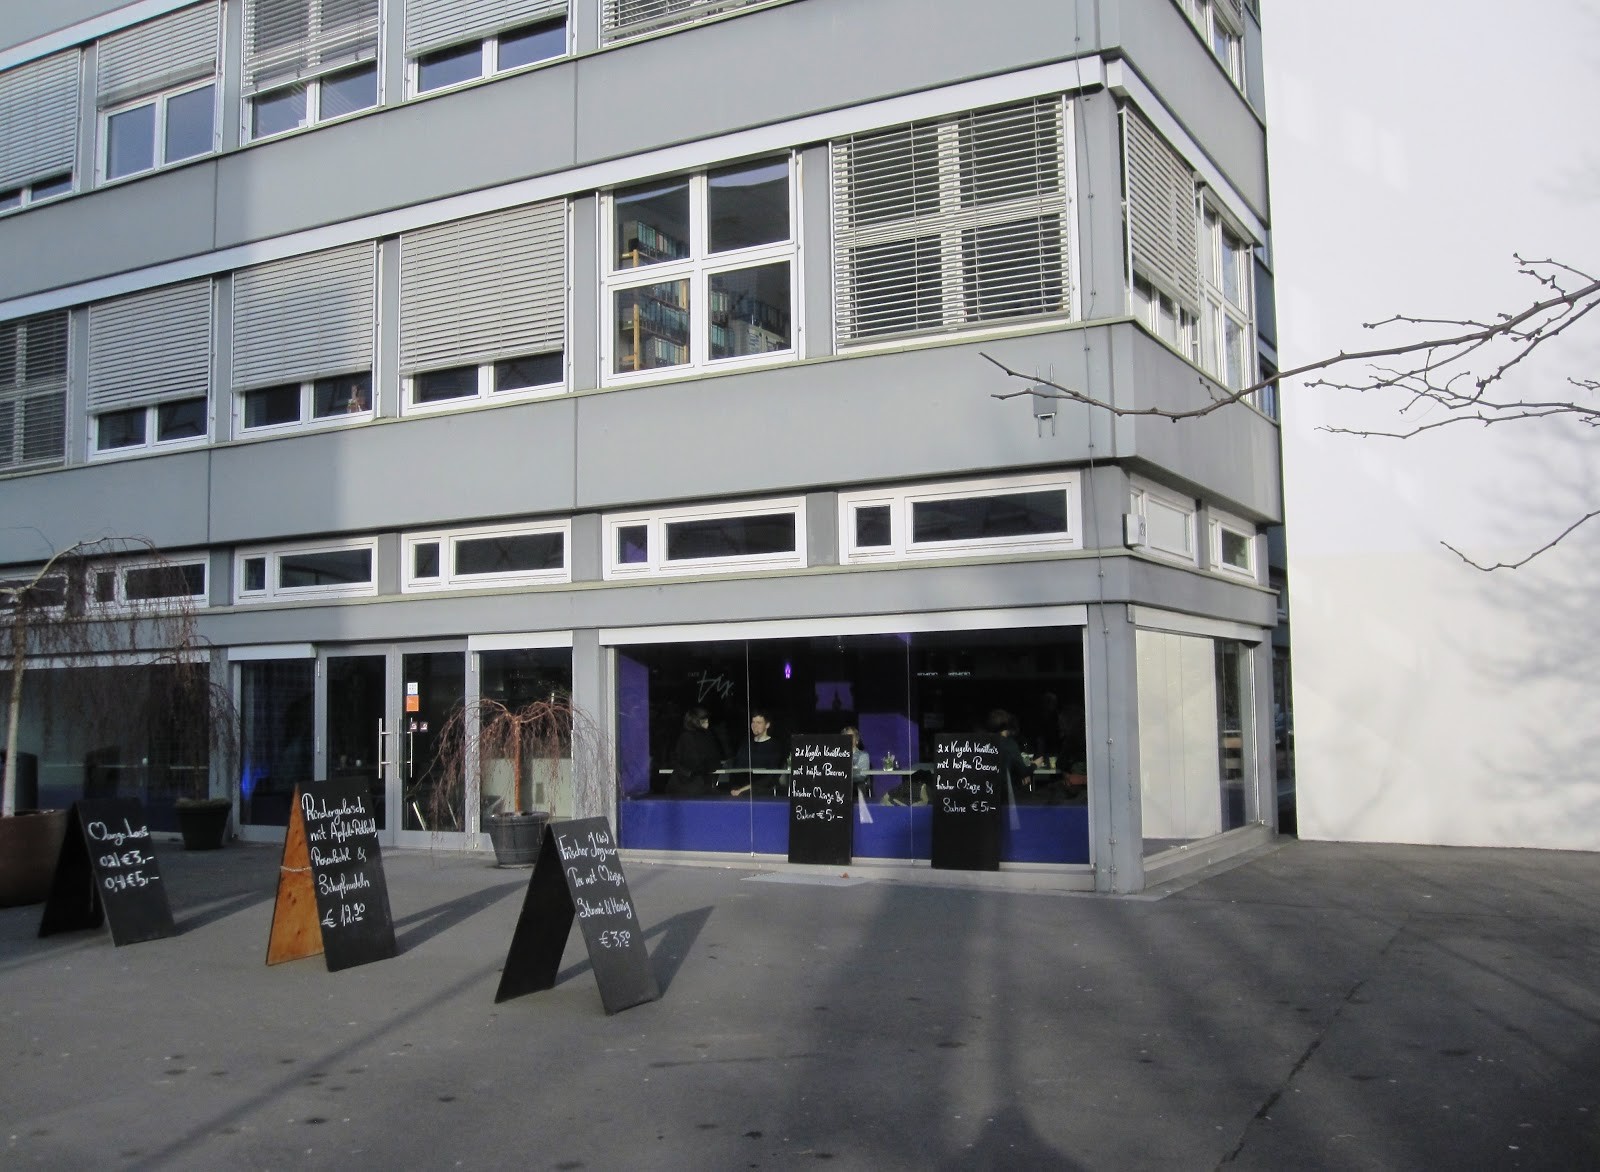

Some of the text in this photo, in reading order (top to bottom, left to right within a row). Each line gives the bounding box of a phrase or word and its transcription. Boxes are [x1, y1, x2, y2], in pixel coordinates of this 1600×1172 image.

[804, 744, 822, 762] Kugeln
[950, 740, 972, 758] Kugeln
[792, 764, 804, 776] mit
[936, 758, 950, 769] mit
[956, 776, 981, 795] Minze
[985, 780, 994, 795] &
[812, 786, 835, 805] Minze
[834, 790, 845, 805] &
[942, 796, 967, 814] Sahne
[301, 792, 366, 826] Rindergulasch
[795, 804, 815, 821] Sahne
[309, 823, 327, 842] mit
[310, 846, 367, 867] Rosenkohl &
[558, 834, 589, 861] Frischer
[566, 866, 585, 888] Tee
[585, 867, 598, 885] mit
[609, 896, 632, 920] Honig
